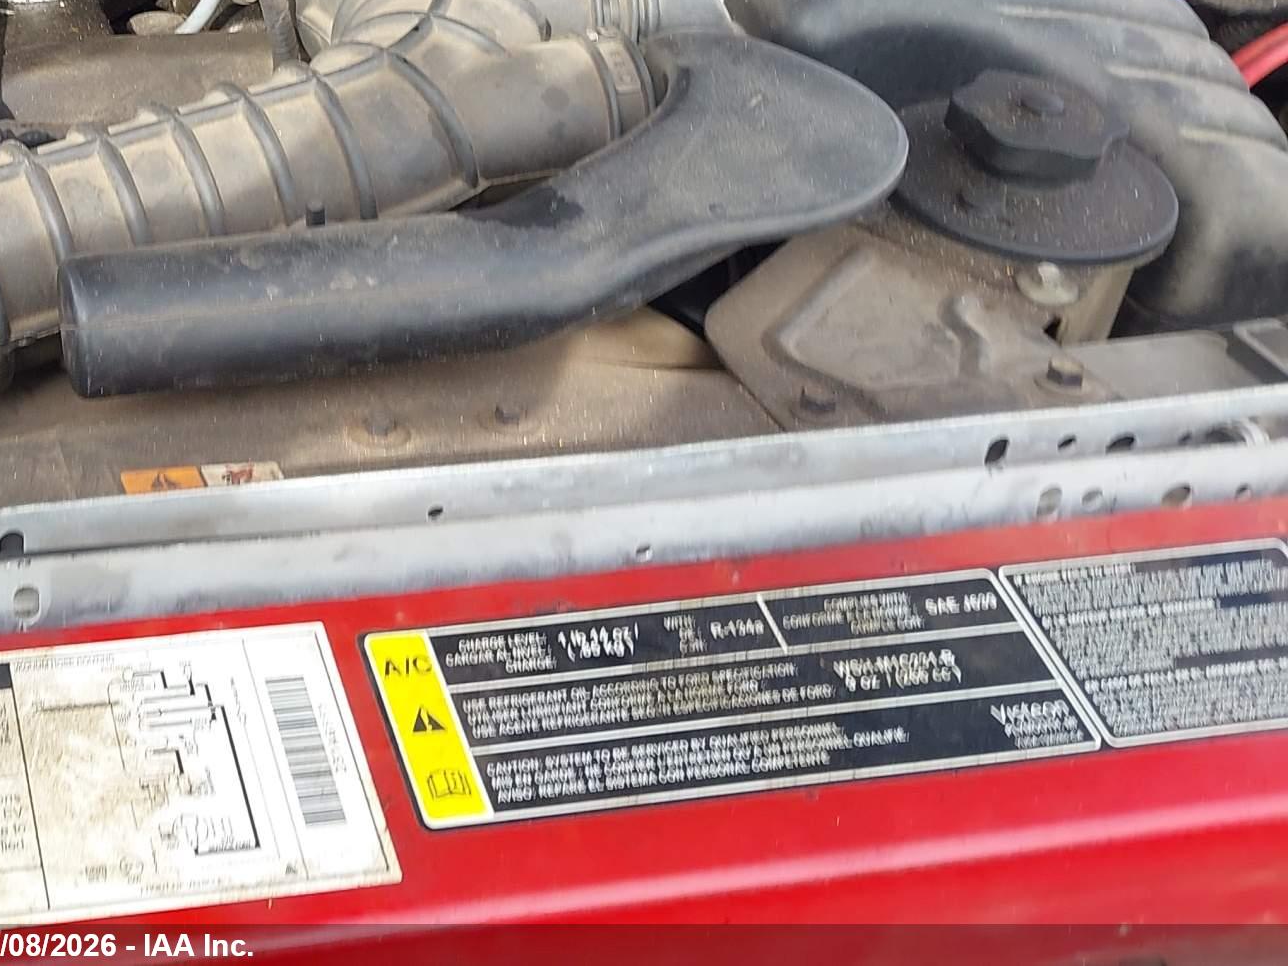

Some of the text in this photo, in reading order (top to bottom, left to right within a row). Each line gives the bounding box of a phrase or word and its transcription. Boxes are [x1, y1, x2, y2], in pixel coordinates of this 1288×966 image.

[925, 595, 959, 616] SAE
[458, 636, 505, 652] CHARGE
[384, 655, 432, 679] A/C
[488, 688, 568, 709] REFRIGERANT
[992, 697, 1068, 724] Visteon
[544, 750, 594, 769] SYSTEM
